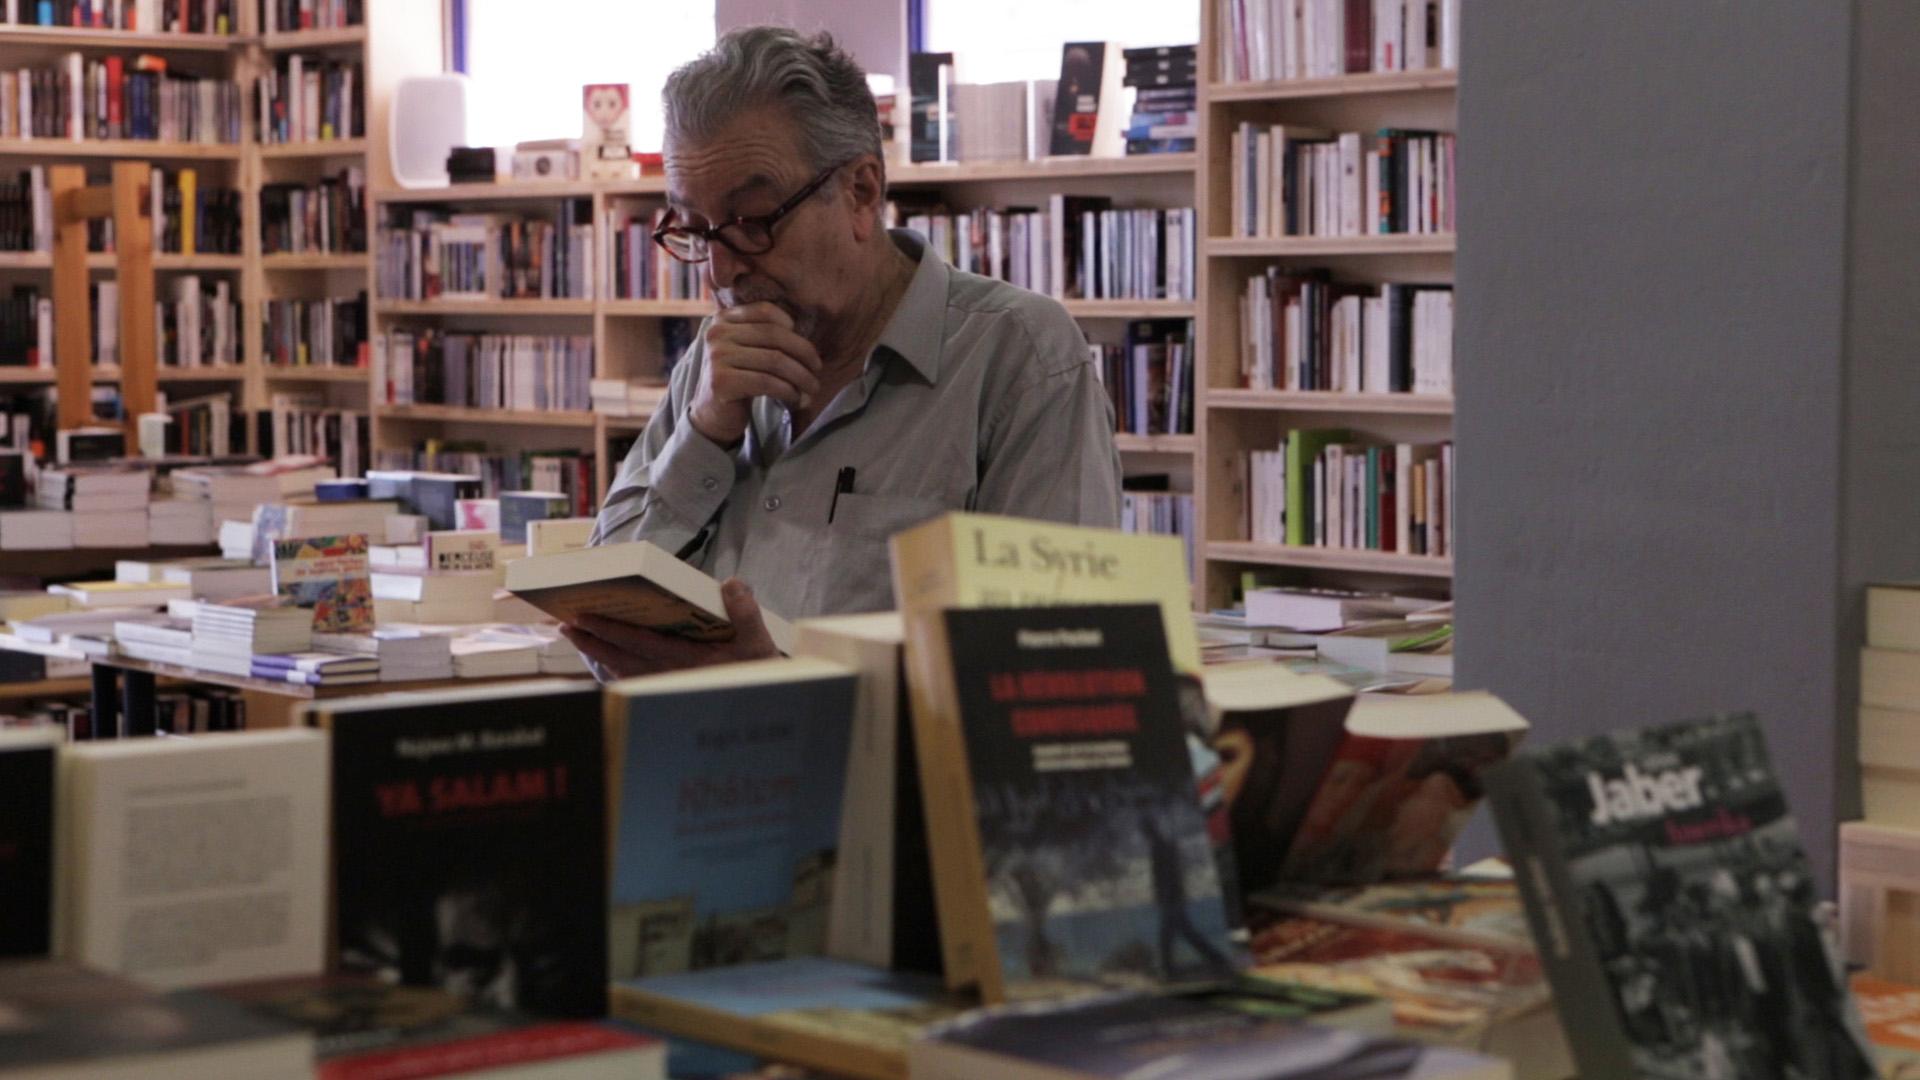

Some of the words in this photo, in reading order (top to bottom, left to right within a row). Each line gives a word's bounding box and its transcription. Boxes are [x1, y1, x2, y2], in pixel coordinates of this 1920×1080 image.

[973, 527, 1020, 569] La
[1030, 535, 1118, 590] Syrie
[430, 767, 548, 811] SALAM
[1587, 763, 1703, 827] Jaber
